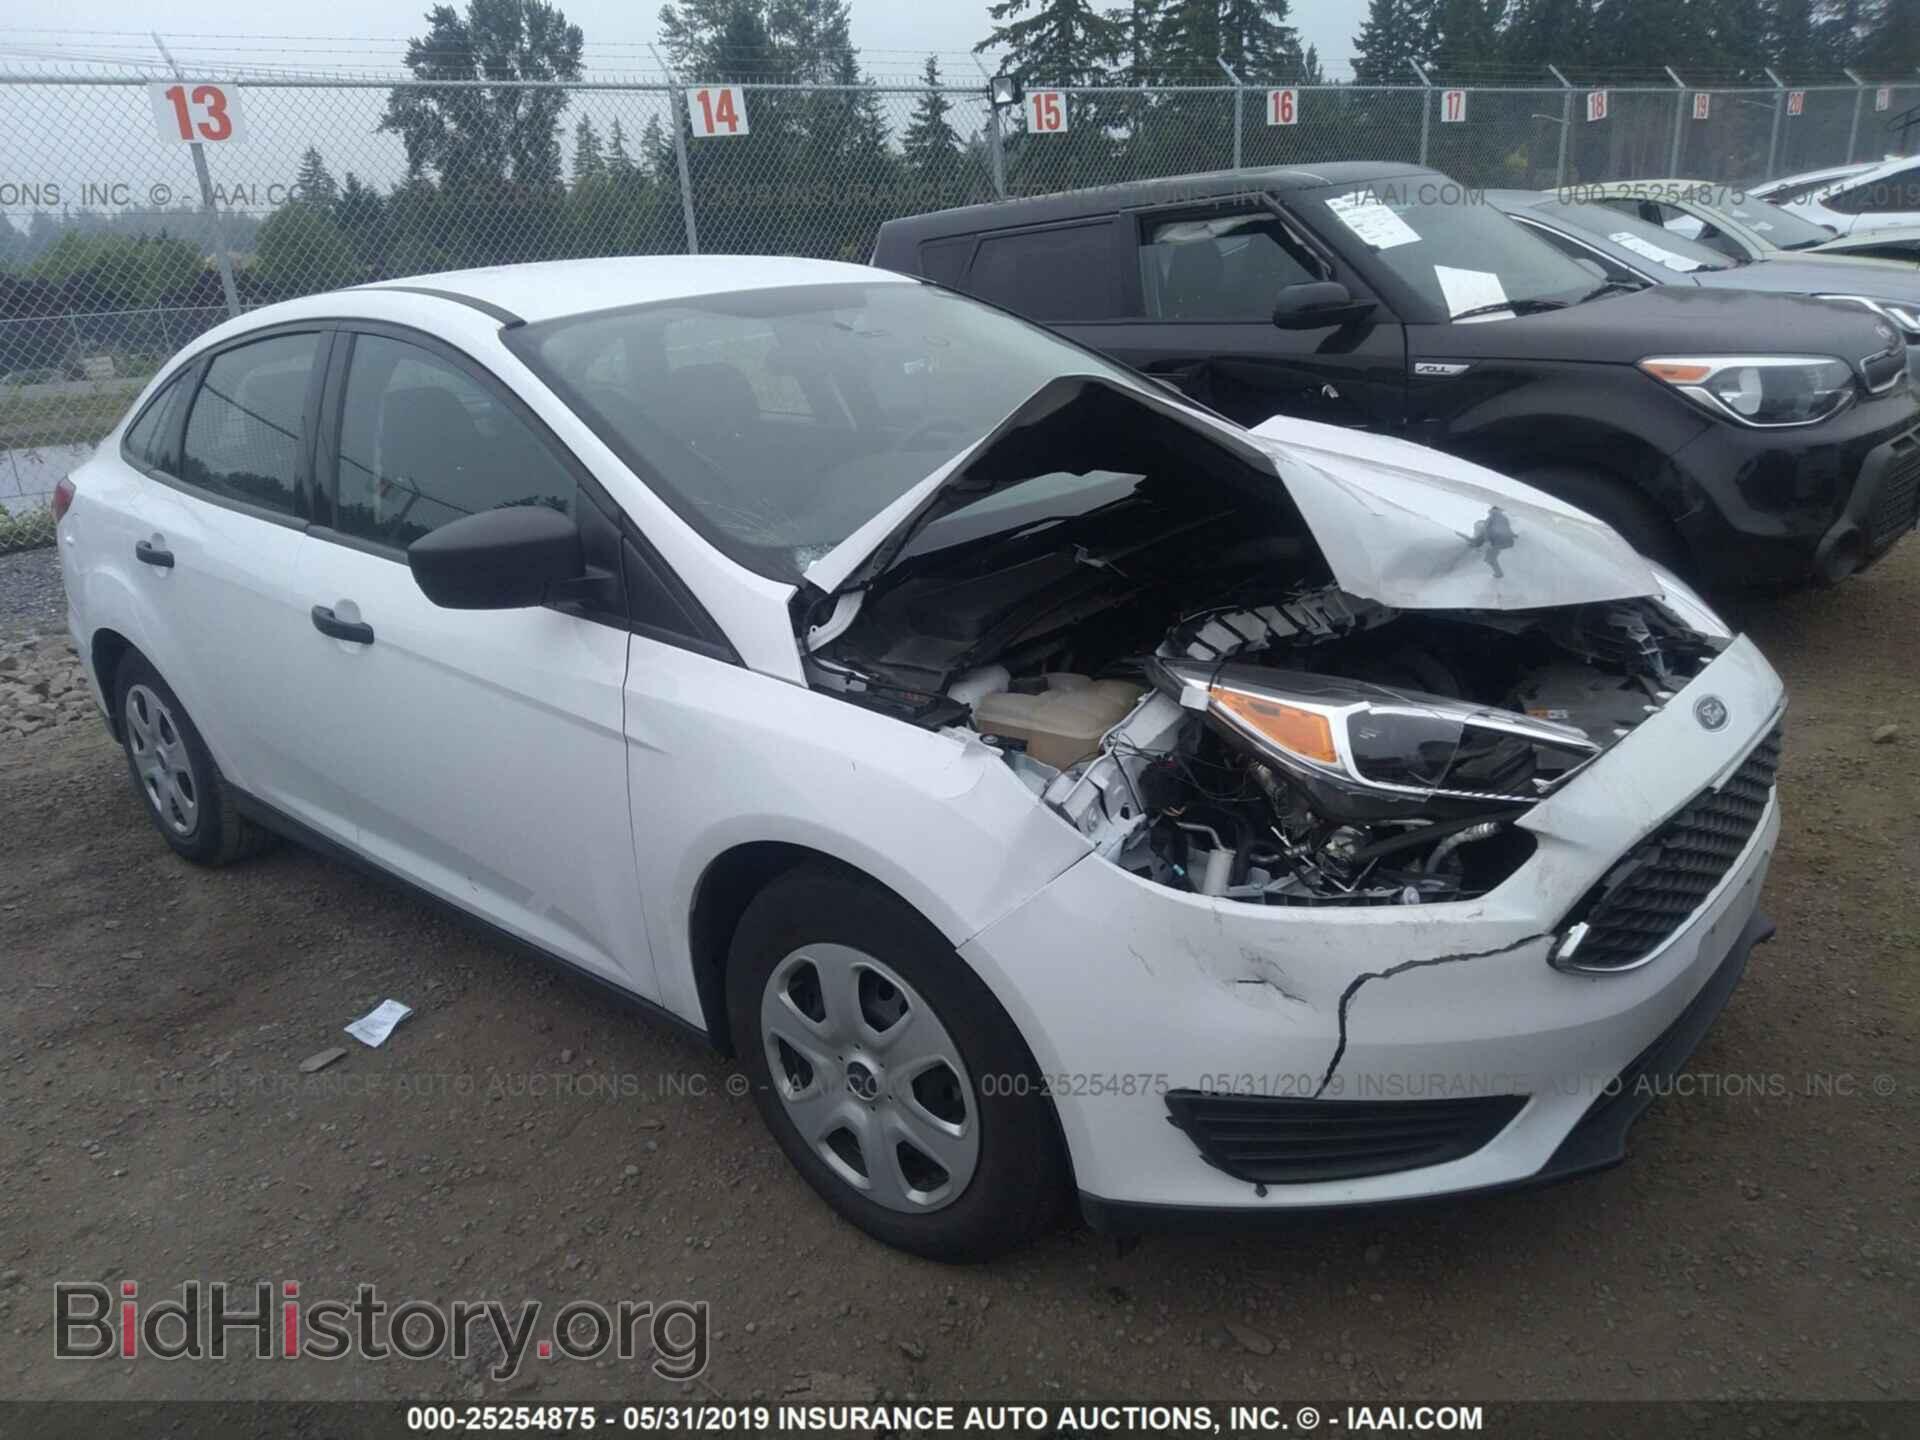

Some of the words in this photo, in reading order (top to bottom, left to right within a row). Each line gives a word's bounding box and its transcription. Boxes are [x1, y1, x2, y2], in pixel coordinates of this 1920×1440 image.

[166, 86, 232, 141] 13
[697, 89, 739, 135] 14
[1033, 93, 1062, 130] 15
[1273, 91, 1293, 124] 16
[1446, 93, 1462, 121] 17
[1592, 93, 1606, 119] 18
[1696, 95, 1707, 118] 19
